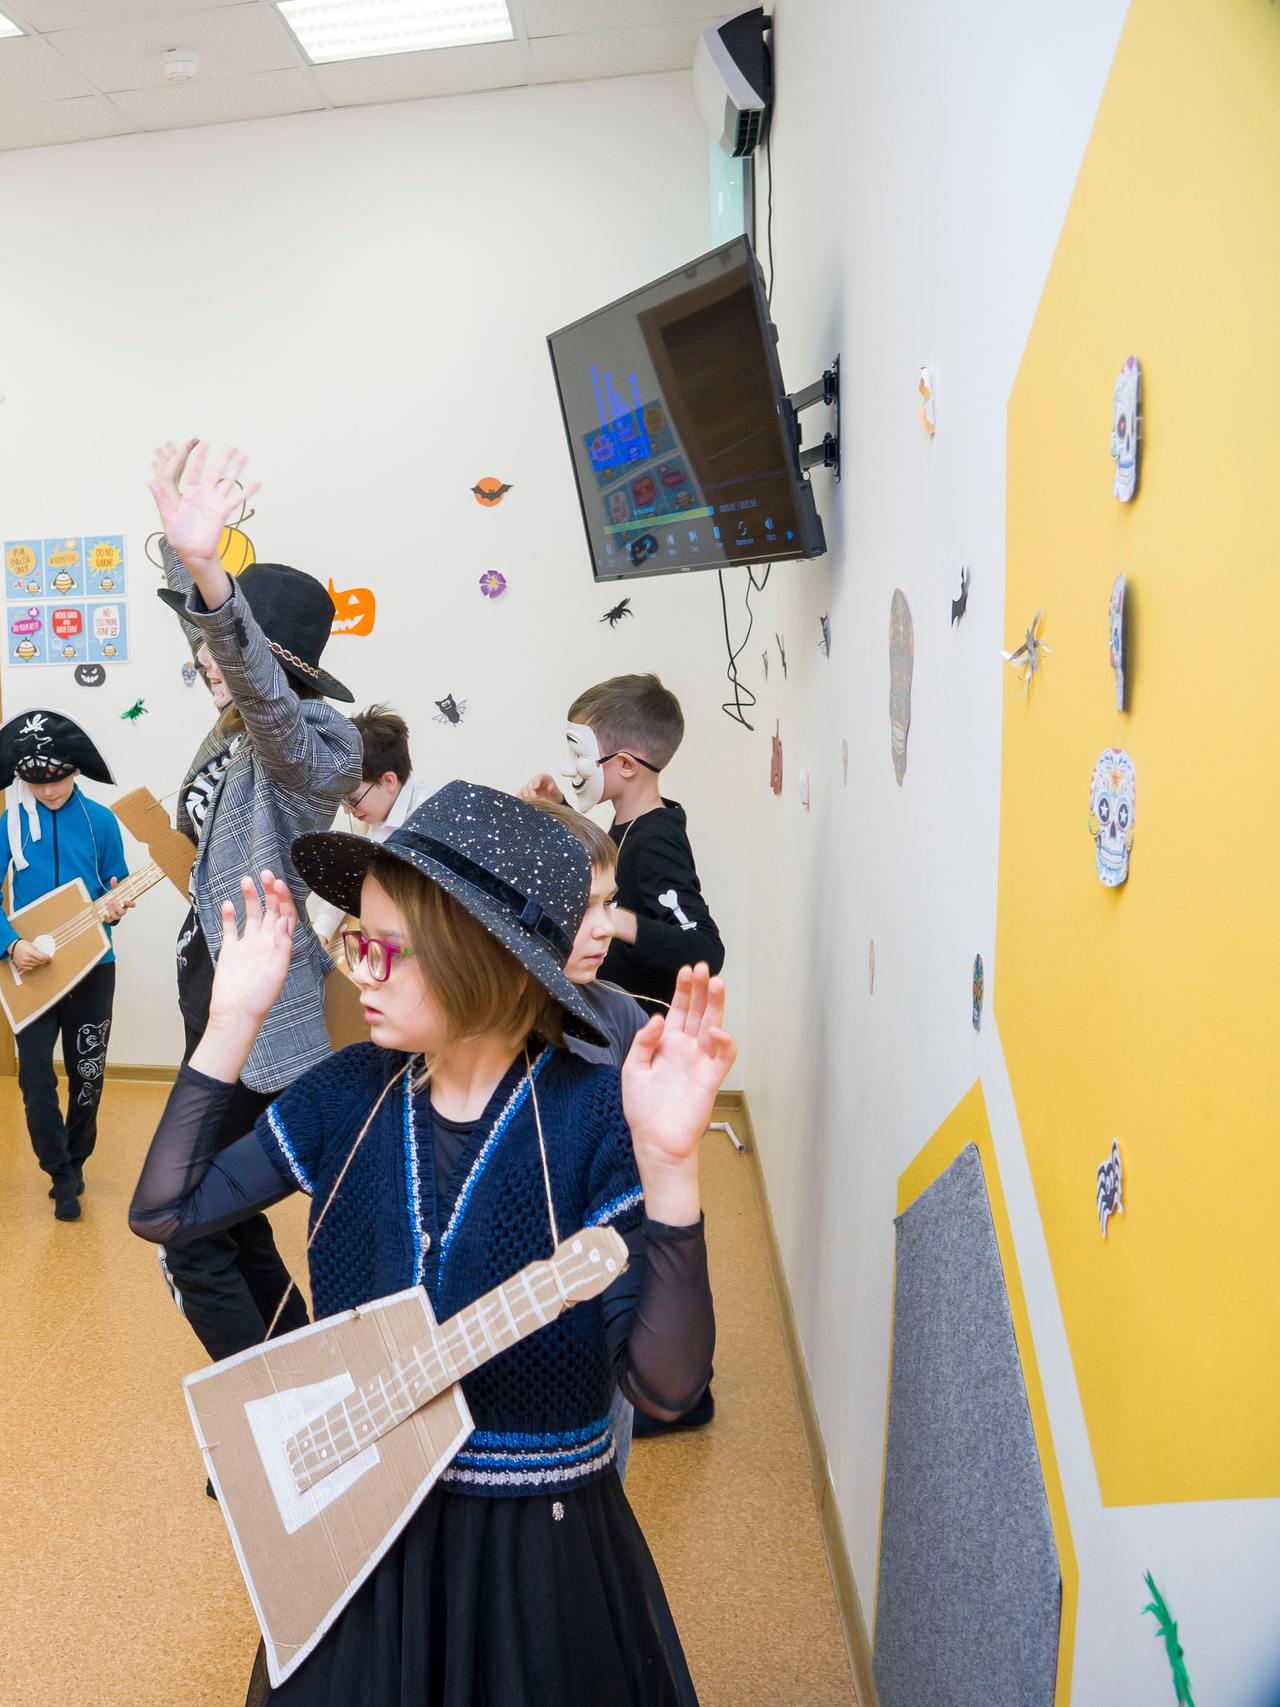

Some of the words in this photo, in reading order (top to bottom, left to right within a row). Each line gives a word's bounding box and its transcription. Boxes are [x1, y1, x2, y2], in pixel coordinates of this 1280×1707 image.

[12, 547, 25, 557] SPEAK
[96, 548, 104, 557] DO
[104, 547, 113, 557] NO
[10, 555, 30, 567] ENGLISH
[96, 558, 113, 567] HARM!
[55, 611, 67, 619] WORK
[67, 611, 77, 619] HARD
[103, 608, 110, 617] NO
[19, 623, 29, 632] YOUR
[29, 621, 39, 631] BEST!
[104, 618, 117, 626] PHONE
[56, 626, 67, 634] HAVE
[67, 625, 78, 633] FUN!
[96, 627, 109, 636] ZONE
